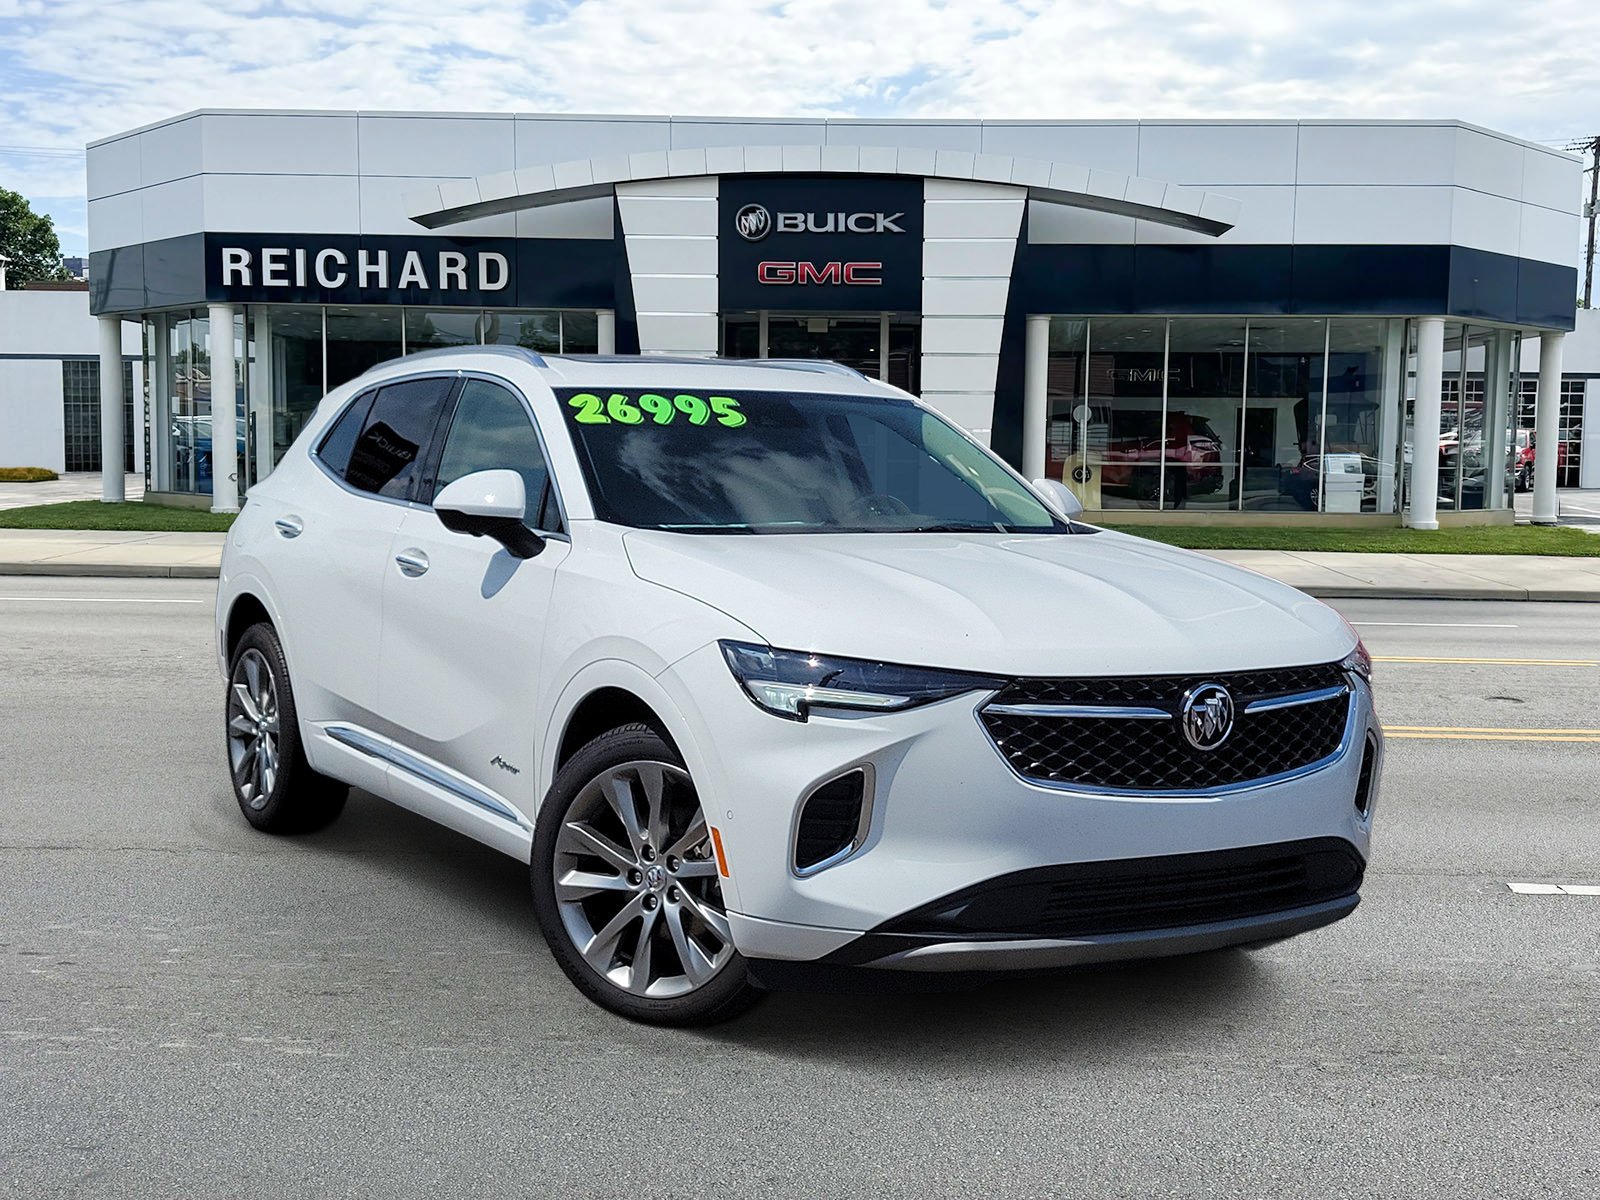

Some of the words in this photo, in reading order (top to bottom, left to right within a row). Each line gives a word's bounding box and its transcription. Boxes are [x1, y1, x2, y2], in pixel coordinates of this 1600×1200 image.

[776, 211, 906, 233] BUICK
[221, 247, 509, 292] REICHARD
[757, 261, 883, 285] GMC
[1106, 367, 1181, 383] GMC
[567, 392, 748, 428] 26995
